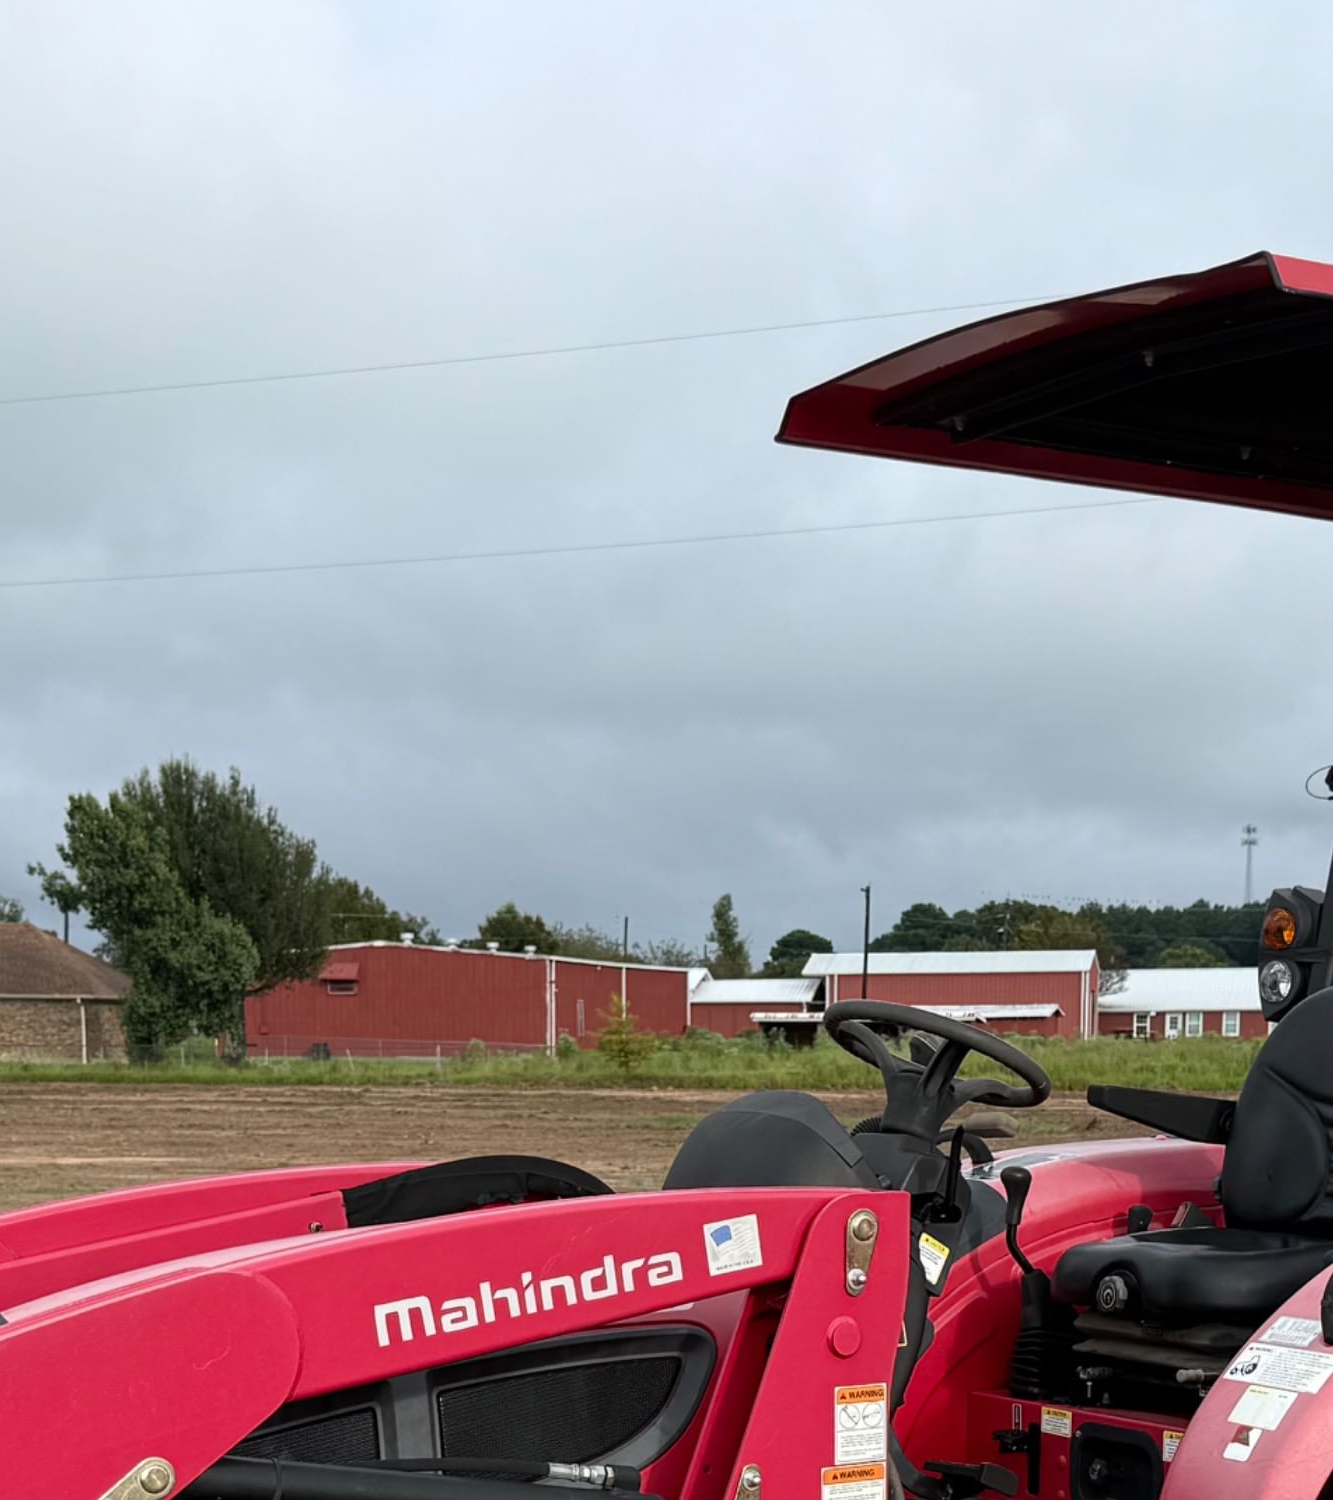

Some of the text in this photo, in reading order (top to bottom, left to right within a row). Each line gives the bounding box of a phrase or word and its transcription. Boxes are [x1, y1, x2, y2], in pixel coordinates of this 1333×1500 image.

[373, 1251, 683, 1347] Mahindra
[848, 1388, 884, 1399] WARNING
[839, 1468, 875, 1479] WARNING
